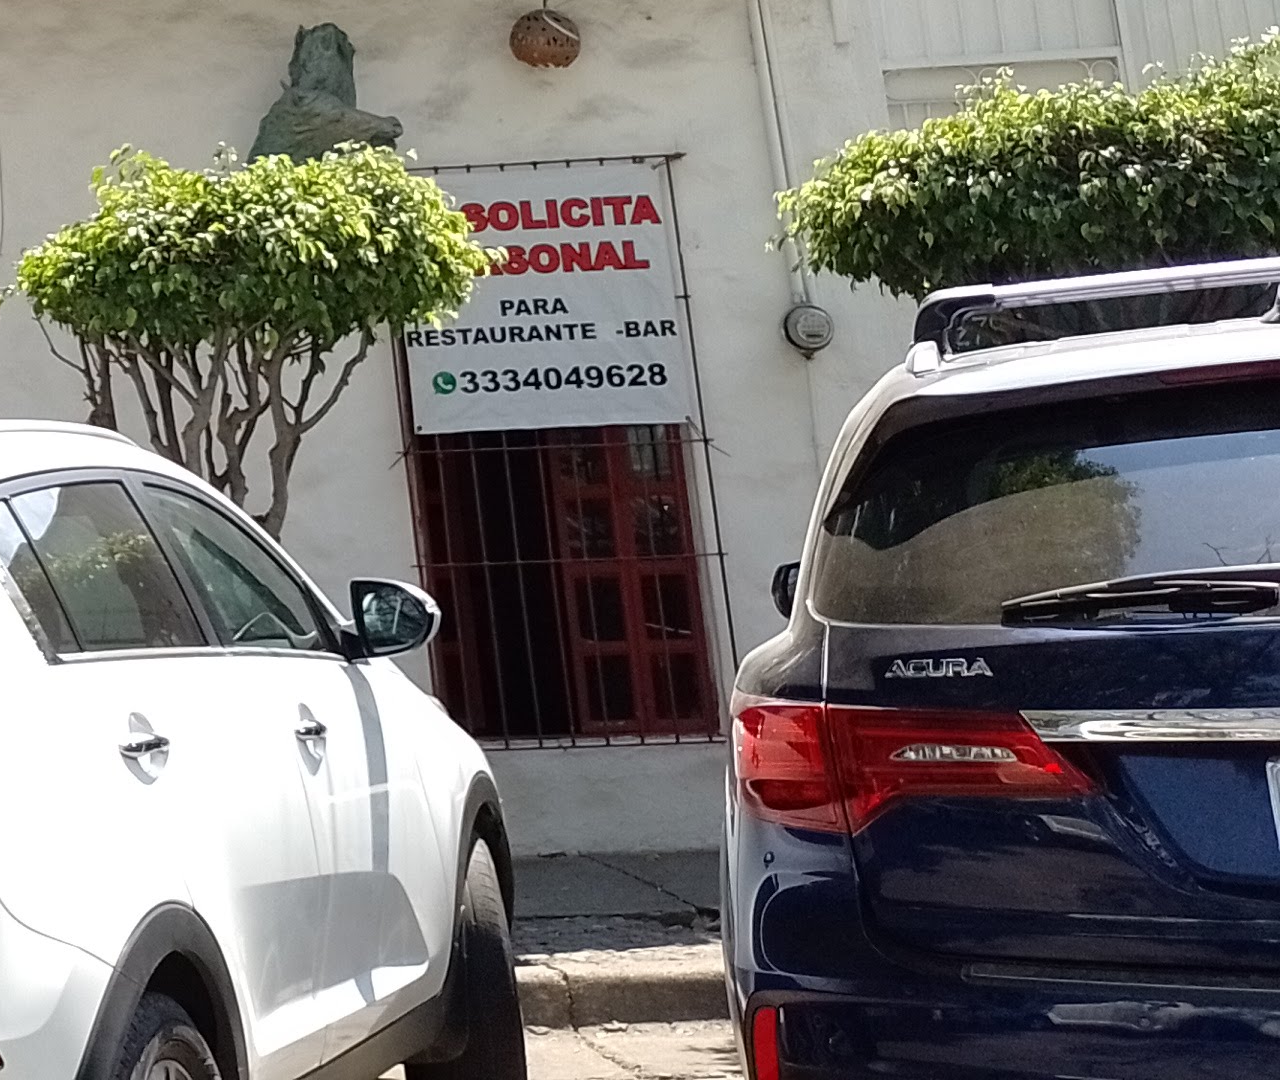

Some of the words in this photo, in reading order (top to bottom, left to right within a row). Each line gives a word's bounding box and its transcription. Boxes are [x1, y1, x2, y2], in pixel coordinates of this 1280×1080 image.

[460, 195, 662, 233] SOLICITA
[500, 297, 569, 316] PARA
[406, 322, 598, 348] RESTAURANTE
[459, 363, 668, 394] 3334049628
[884, 657, 994, 679] ACURA
